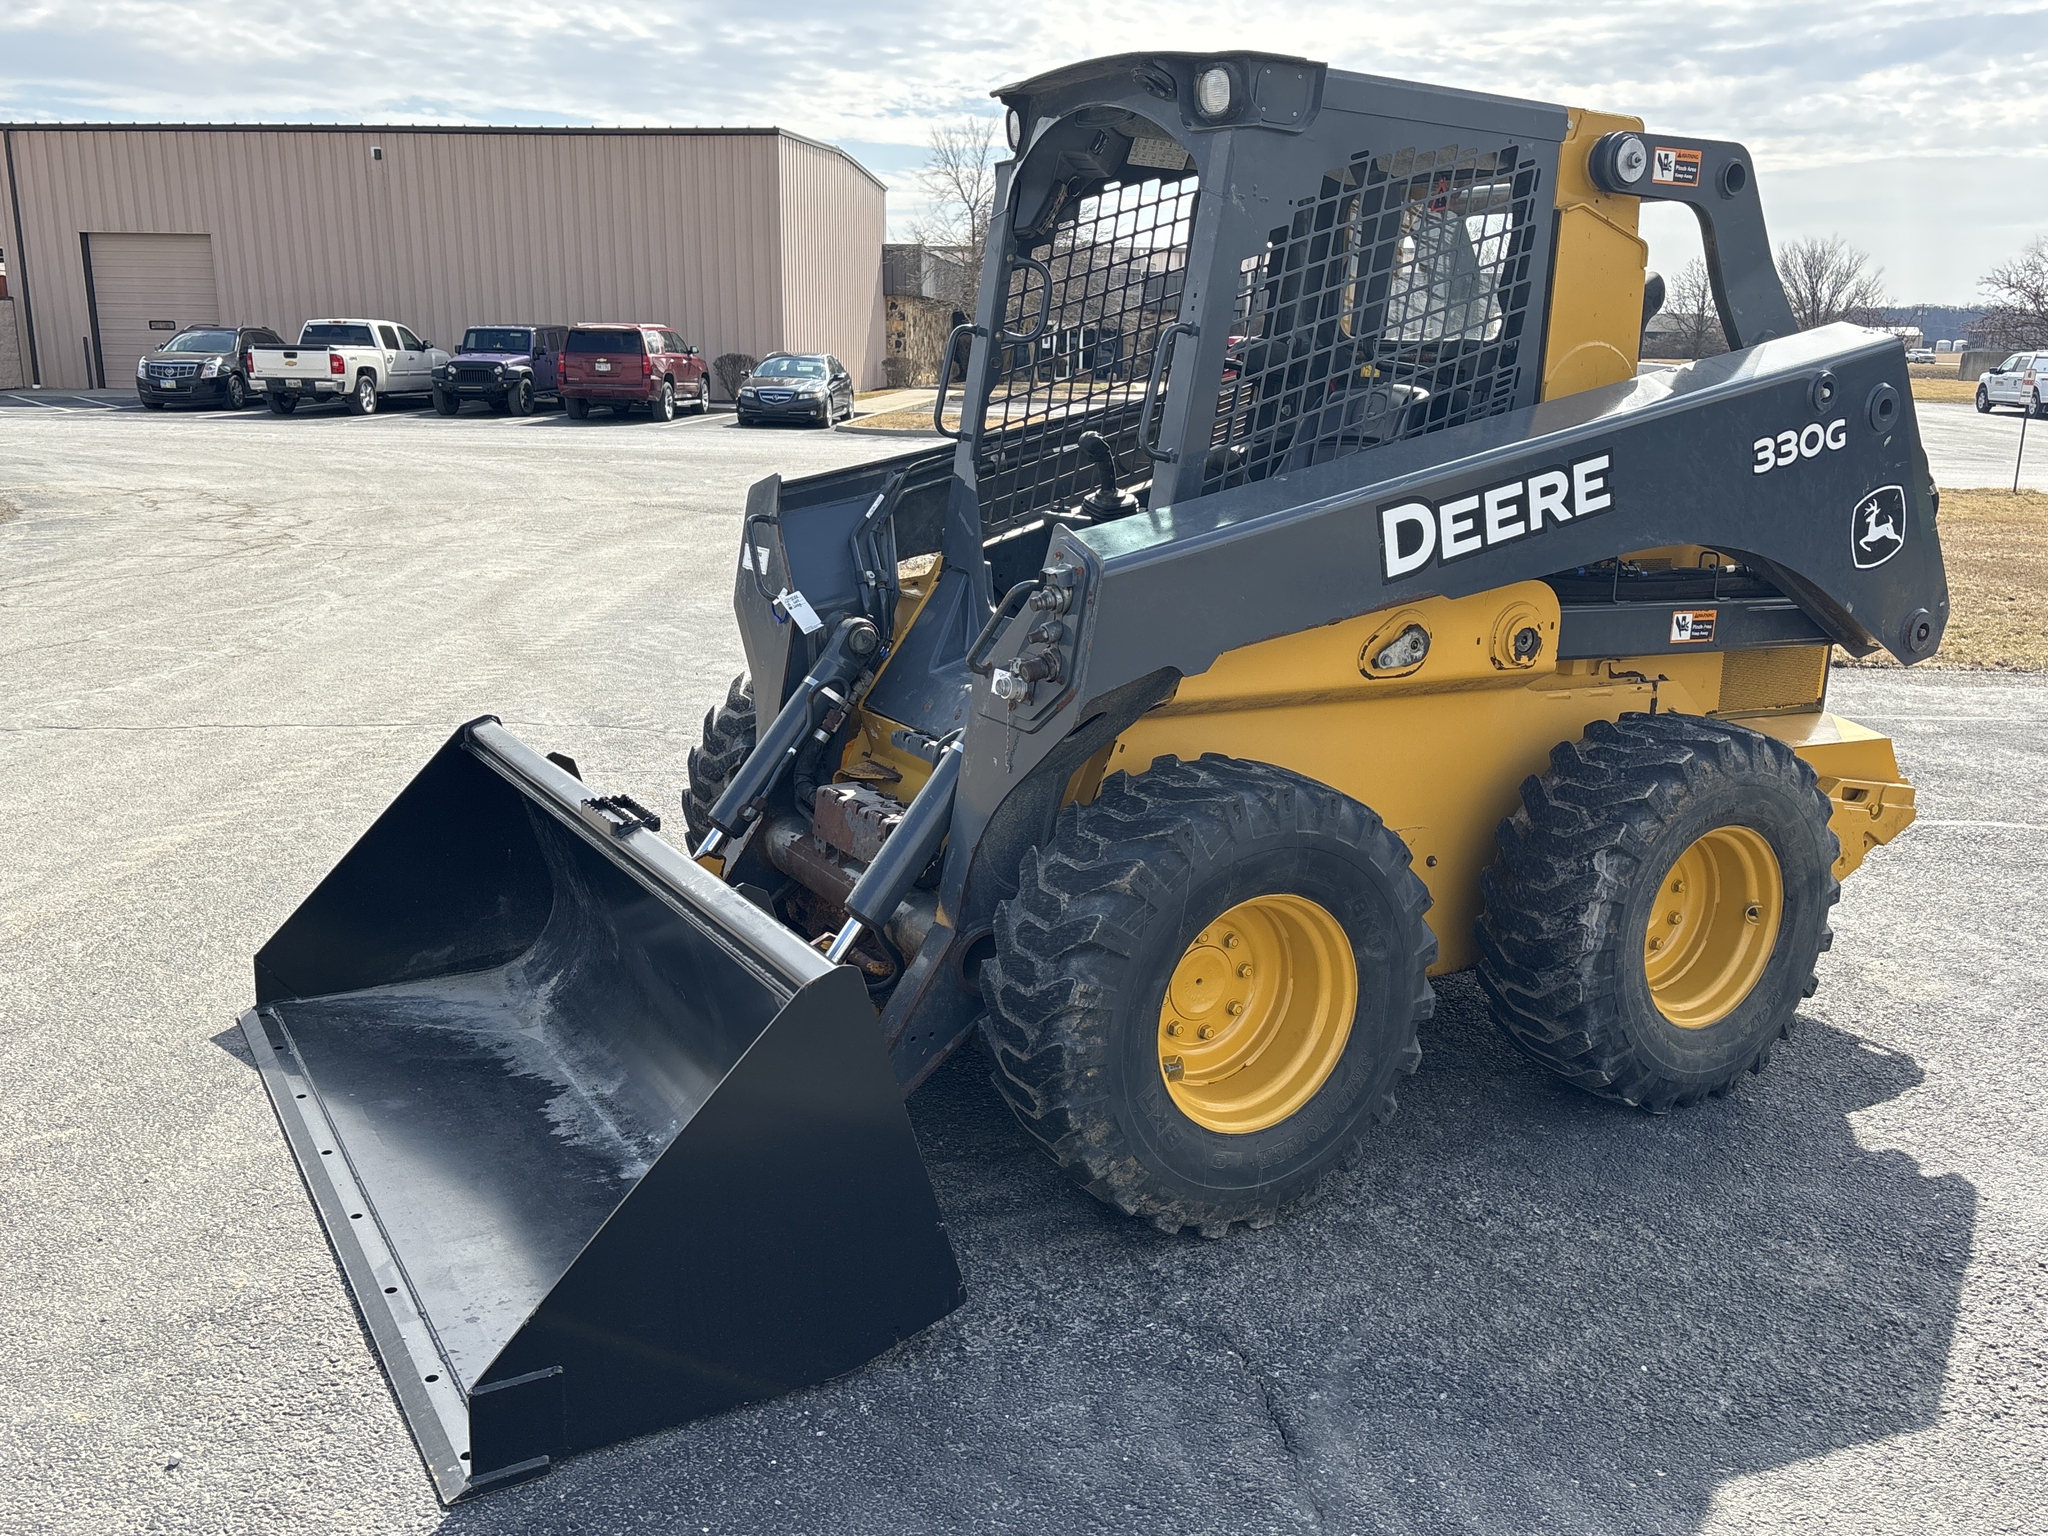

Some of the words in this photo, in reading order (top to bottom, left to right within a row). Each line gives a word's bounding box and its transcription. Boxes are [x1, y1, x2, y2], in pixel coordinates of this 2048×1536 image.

[1753, 418, 1846, 473] 330G
[1382, 454, 1611, 578] DEERE
[1344, 891, 1392, 957] BKT
[1333, 1050, 1375, 1114] SKID
[1135, 1081, 1183, 1152] BKT
[1257, 1108, 1335, 1169] POWER
